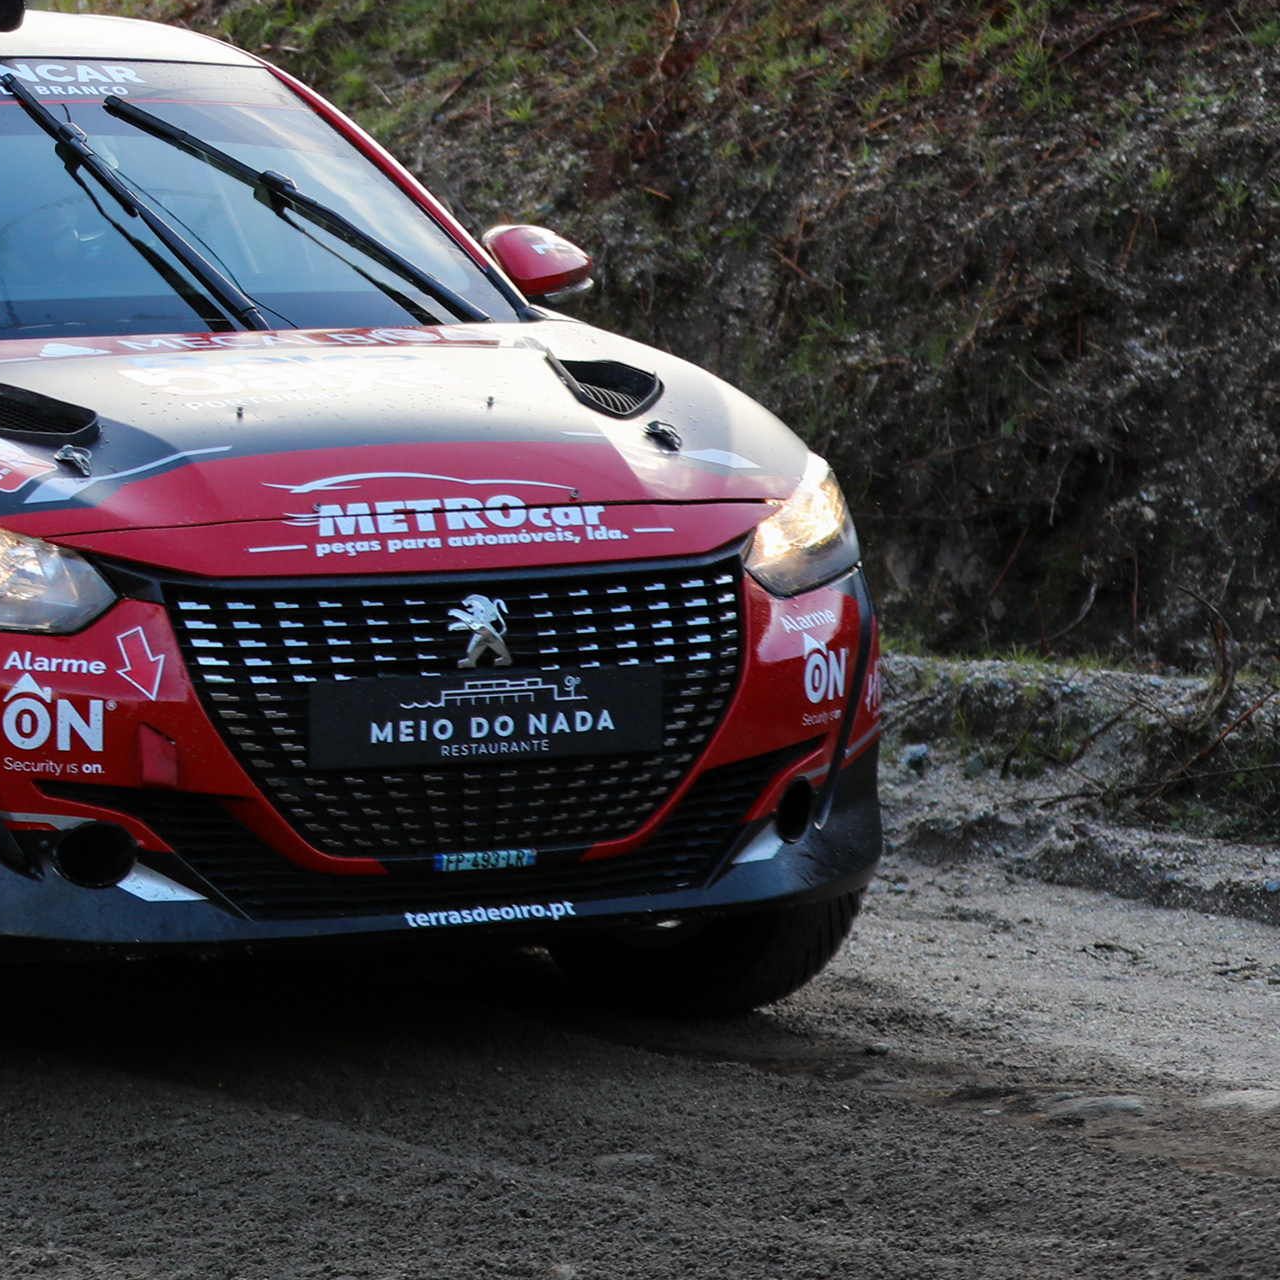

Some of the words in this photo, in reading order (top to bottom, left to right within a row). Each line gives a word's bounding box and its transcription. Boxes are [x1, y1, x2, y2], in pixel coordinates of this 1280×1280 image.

[38, 84, 129, 97] BRANCO
[318, 494, 606, 537] METROcar
[315, 540, 382, 557] peças
[387, 536, 442, 554] para
[447, 528, 582, 548] automóveis,
[780, 608, 838, 634] Alarme
[3, 651, 107, 675] Alarme
[804, 647, 847, 704] ON
[2, 697, 104, 751] ON
[370, 718, 454, 744] MEIO
[470, 715, 515, 739] DO
[528, 709, 616, 735] NADA
[441, 739, 550, 757] RESTAURANTE
[3, 756, 64, 776] Security
[66, 762, 79, 773] is
